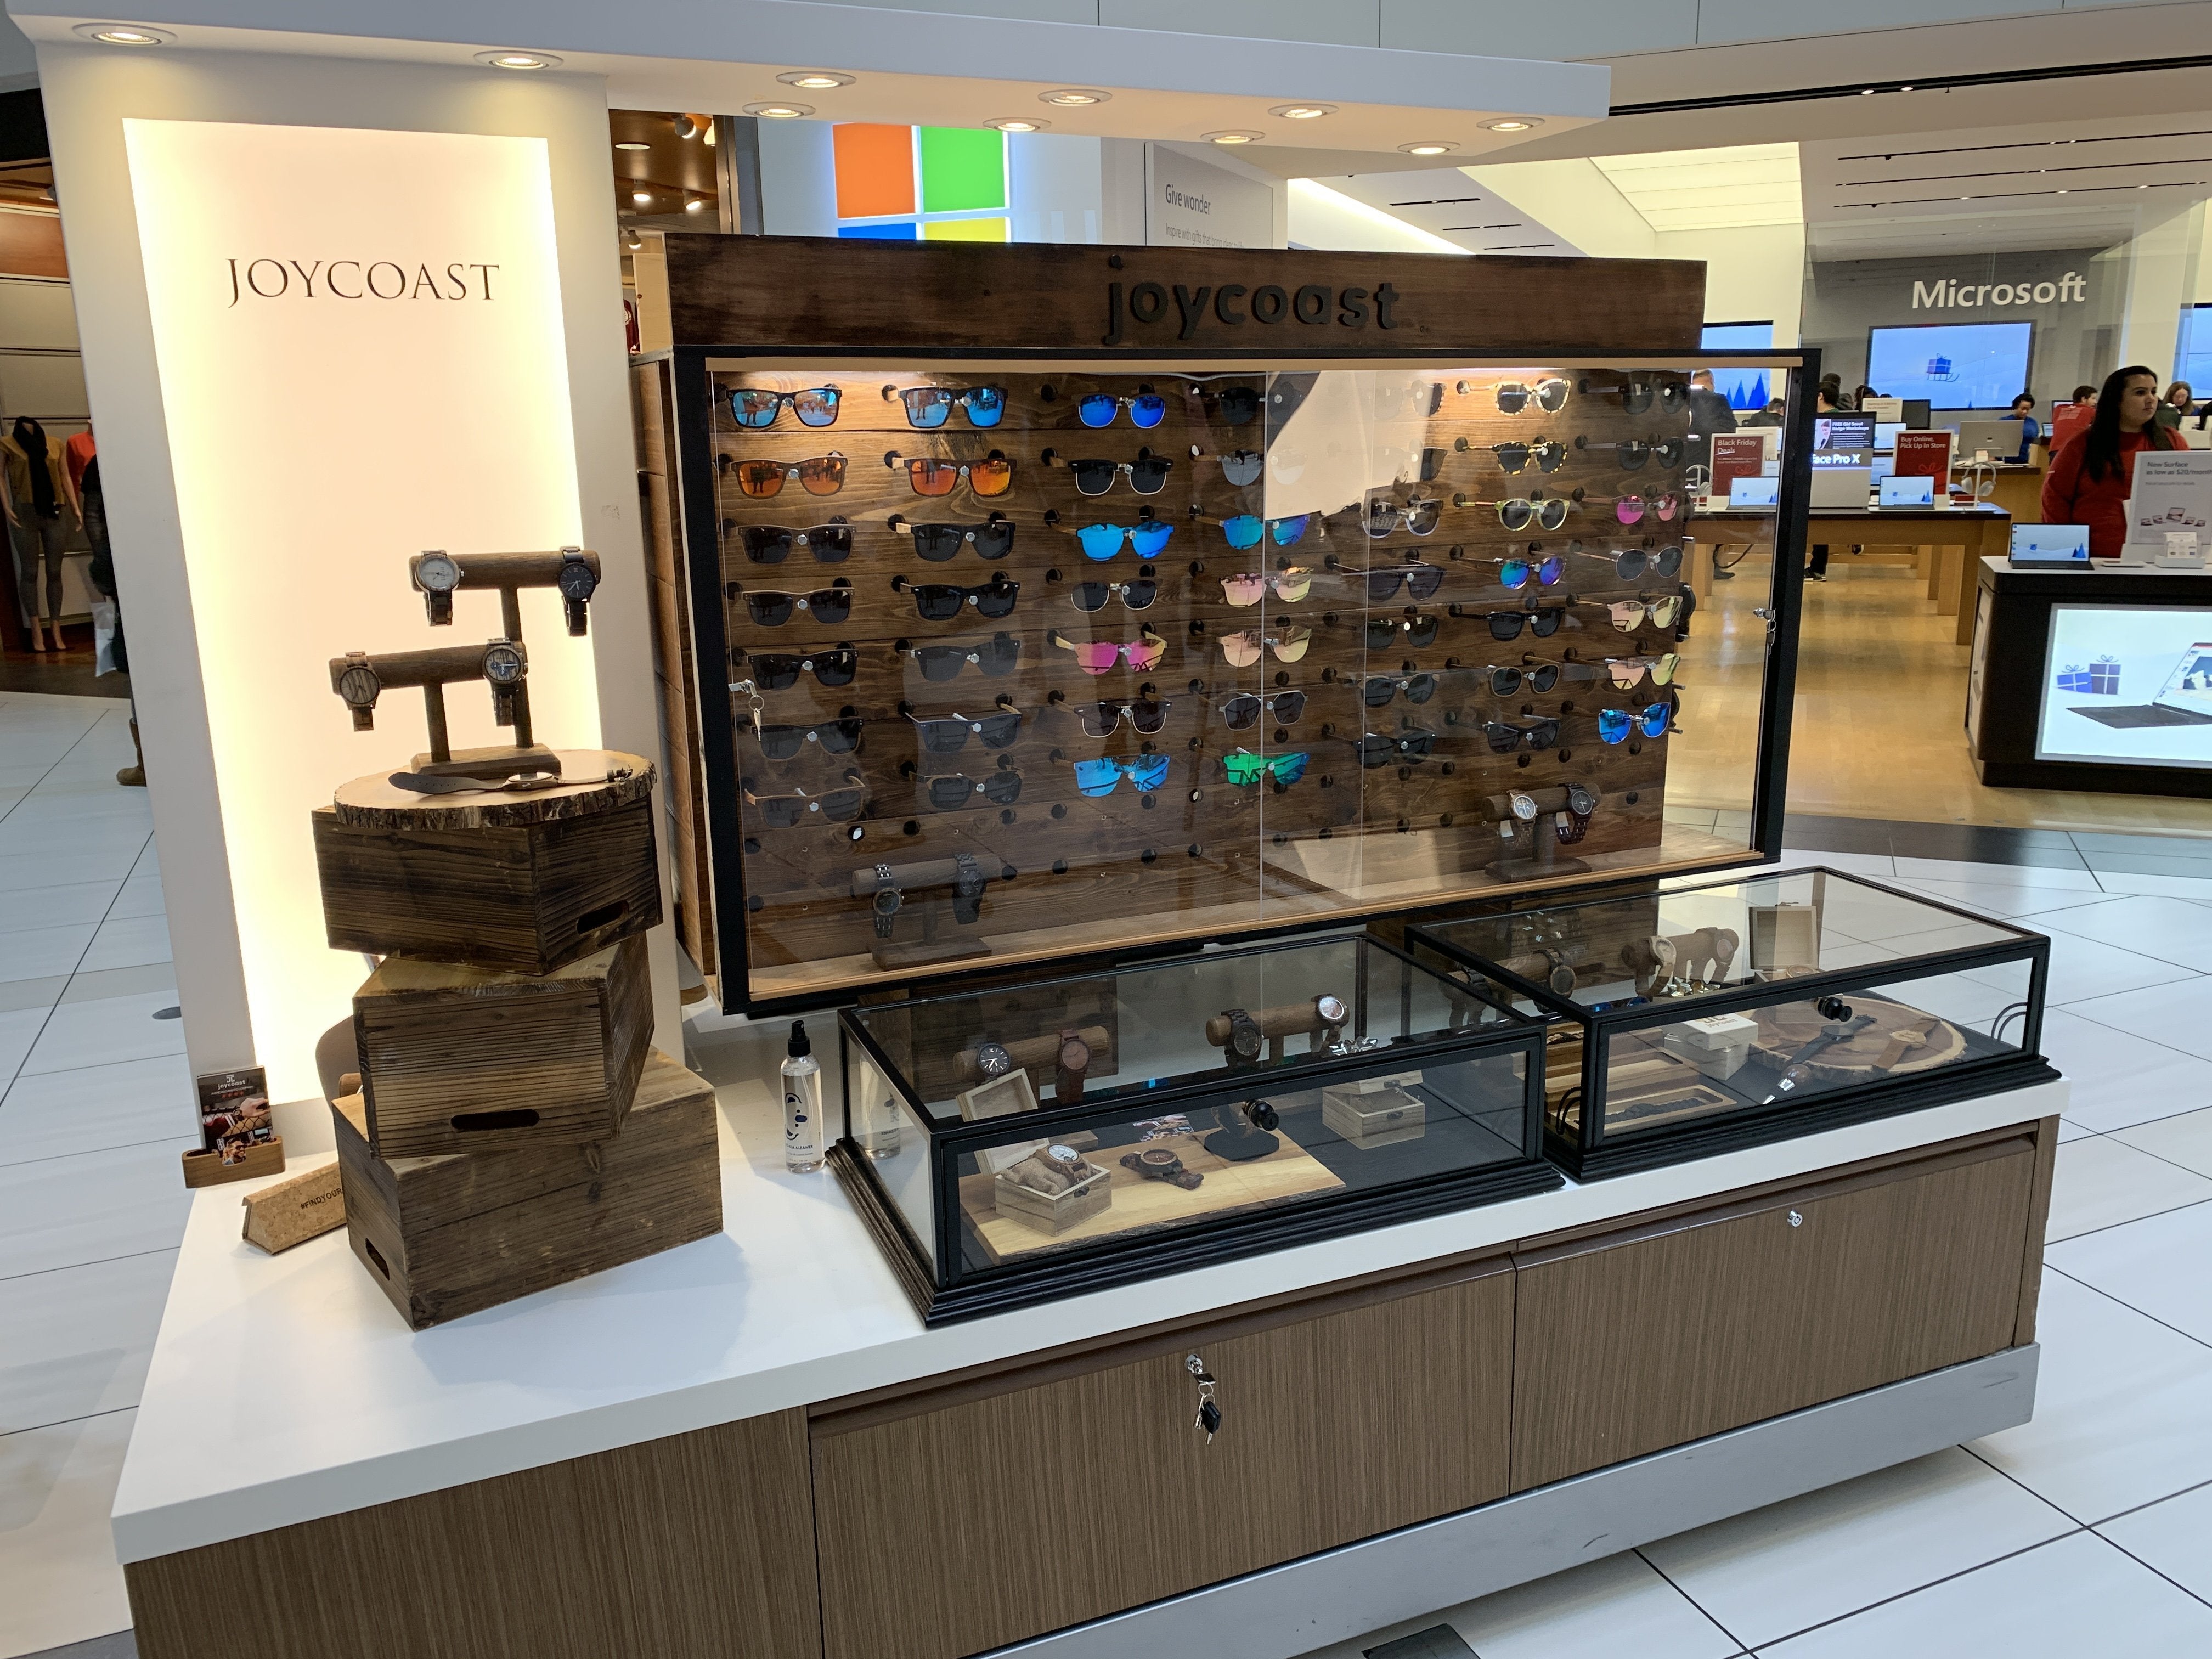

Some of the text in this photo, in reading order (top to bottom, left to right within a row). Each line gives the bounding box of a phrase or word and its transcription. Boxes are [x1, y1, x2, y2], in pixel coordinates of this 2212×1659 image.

[1166, 184, 1211, 215] Give wonder
[1166, 222, 1181, 239] Inspire
[1182, 228, 1192, 240] with
[1192, 229, 1202, 245] gifts
[1203, 232, 1211, 245] that
[225, 258, 500, 309] JOYCOAST
[1912, 272, 2087, 309] Microsoft
[1101, 254, 1399, 346] joycoast
[1736, 439, 1757, 447] Friday
[1832, 454, 1850, 464] Pro
[1852, 454, 1861, 464] X
[218, 1080, 246, 1091] joycoast
[300, 1188, 343, 1210] #FINDYOUR
